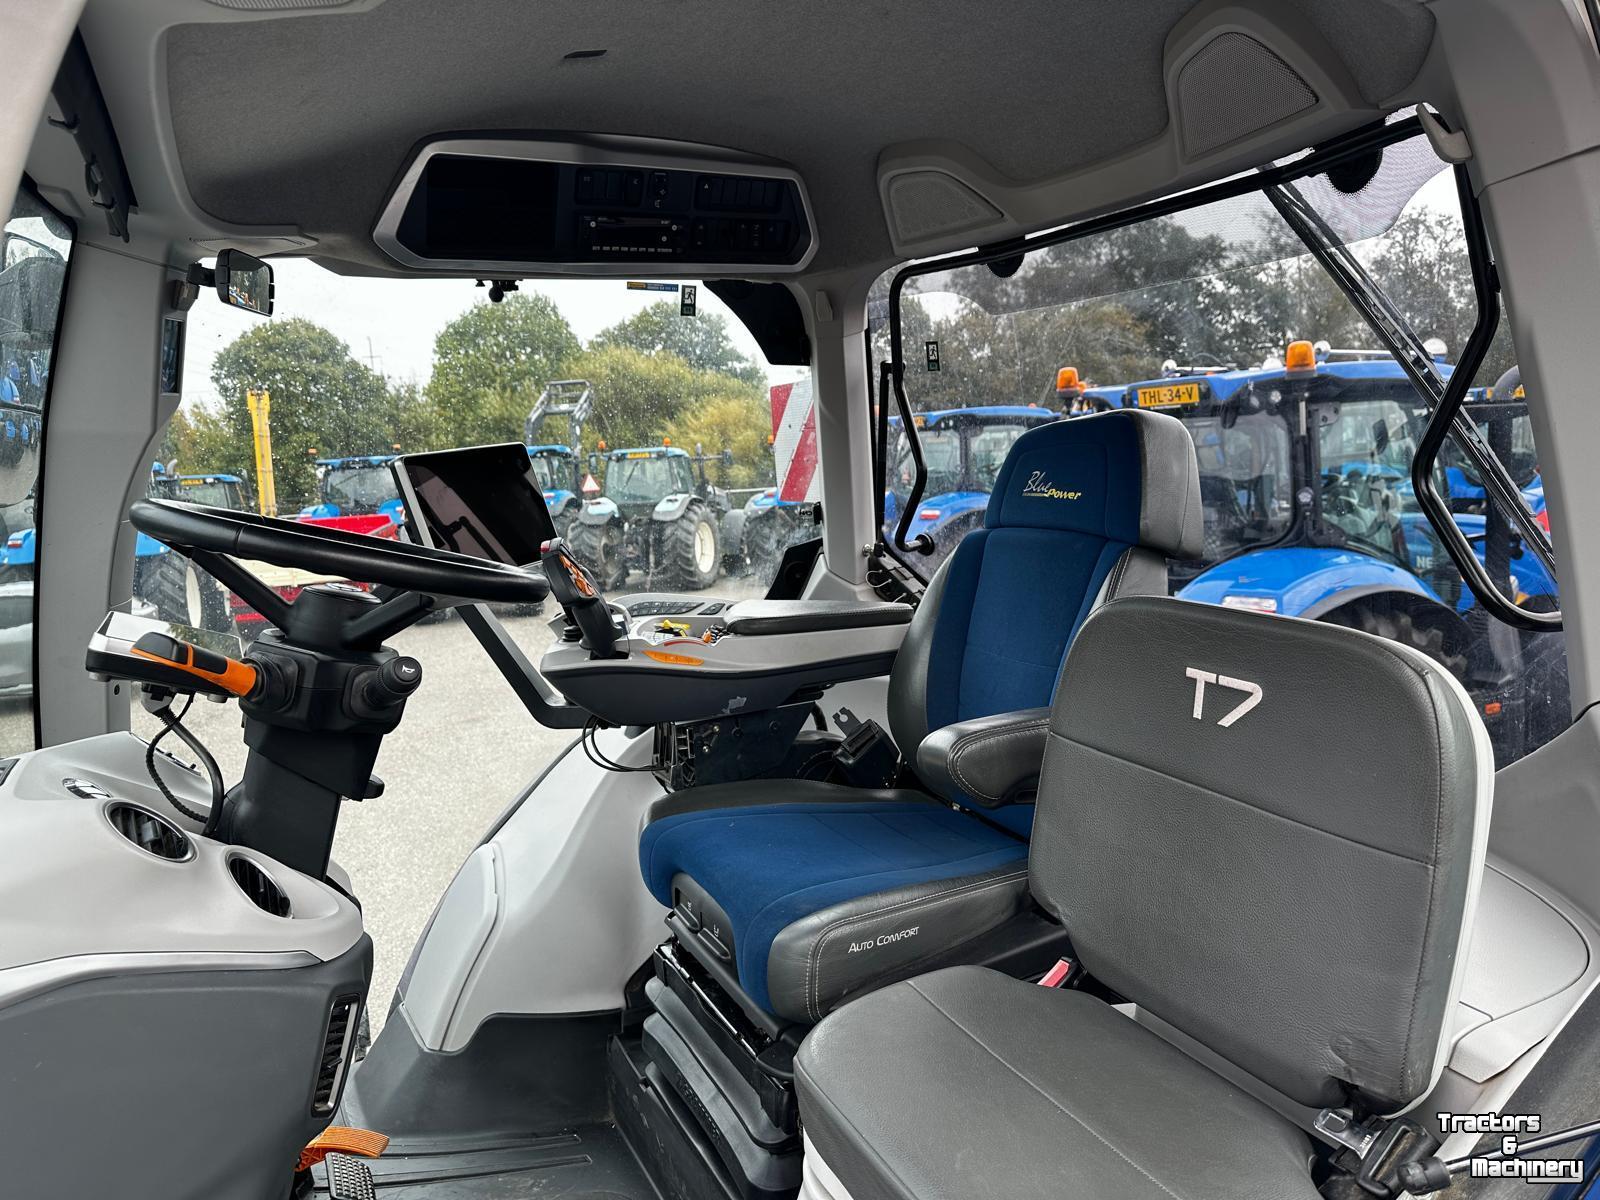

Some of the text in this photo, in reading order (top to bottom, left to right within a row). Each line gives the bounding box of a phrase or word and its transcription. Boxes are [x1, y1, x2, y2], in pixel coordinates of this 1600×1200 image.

[1141, 386, 1194, 404] THL-34-V
[1416, 555, 1433, 568] NE
[1185, 666, 1263, 728] T7
